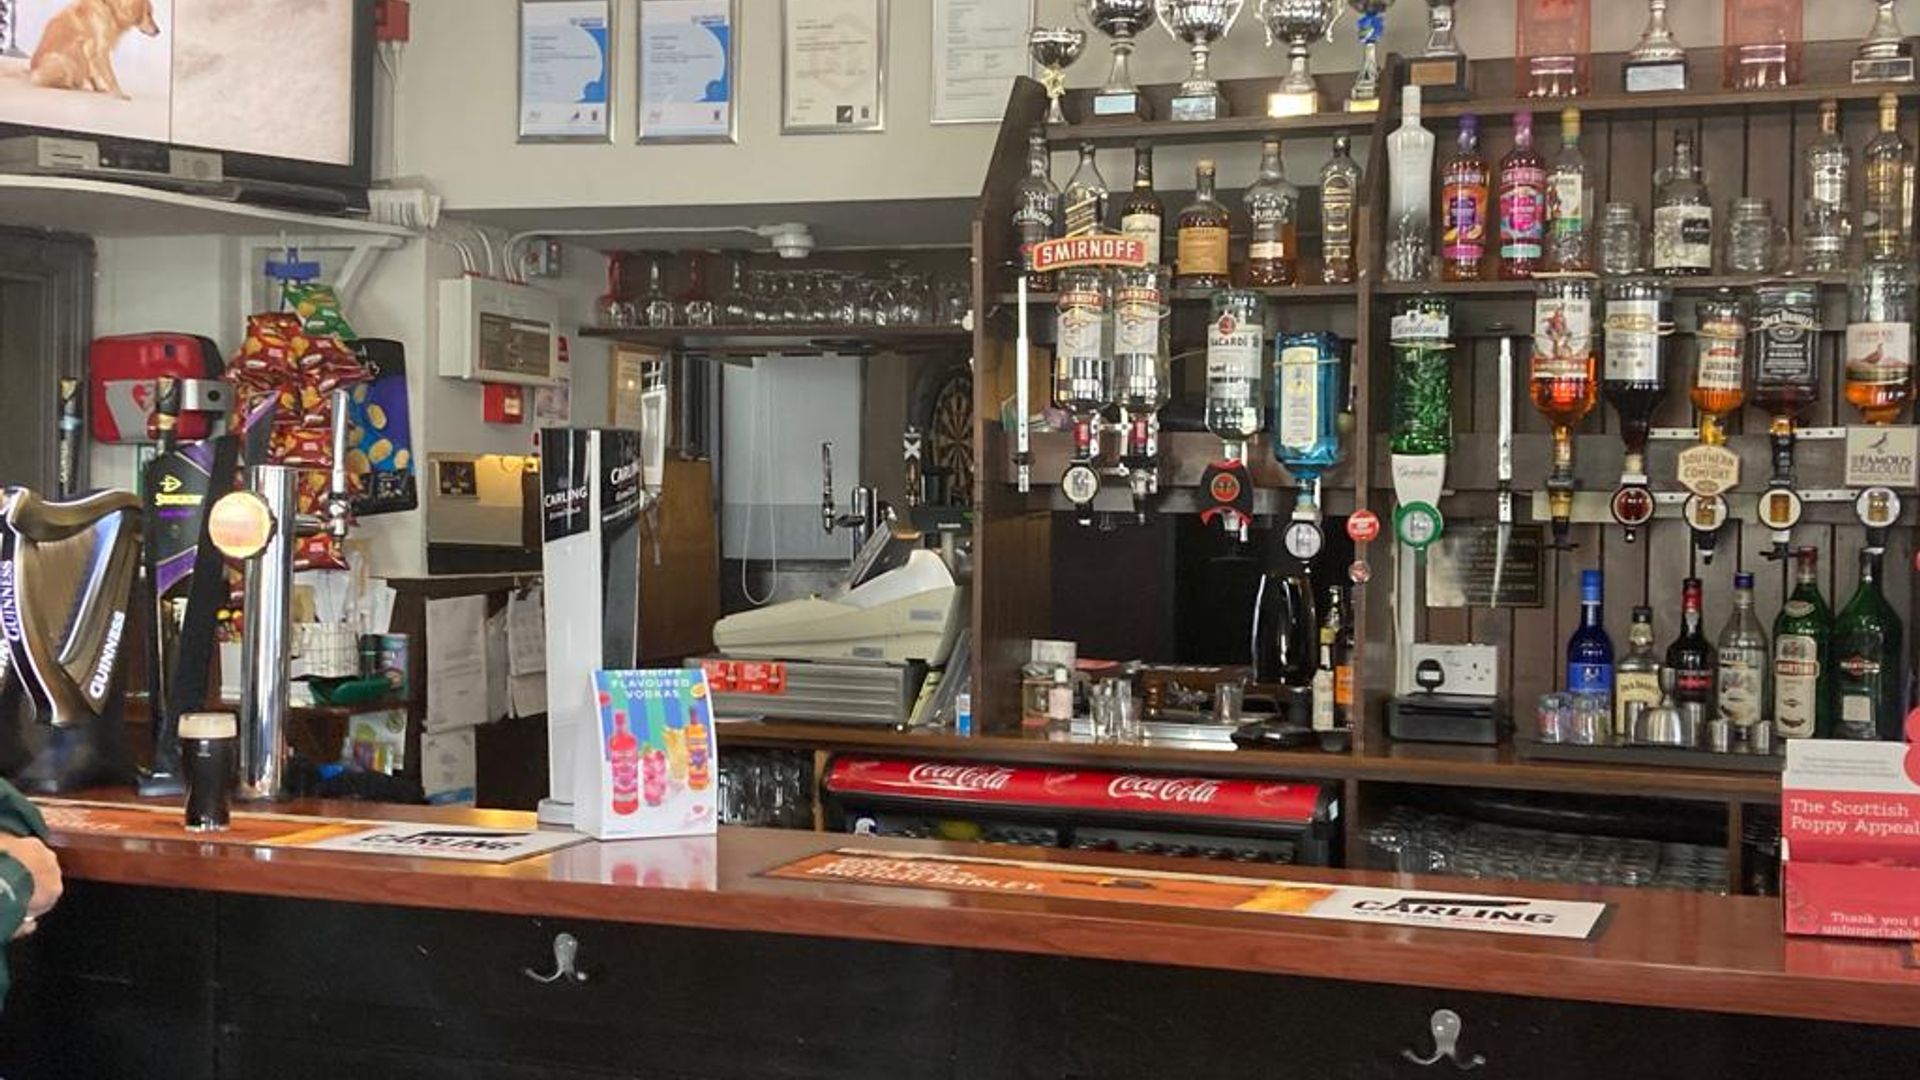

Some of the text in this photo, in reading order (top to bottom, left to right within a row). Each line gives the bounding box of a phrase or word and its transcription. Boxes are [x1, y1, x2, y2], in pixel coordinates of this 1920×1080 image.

[1251, 208, 1283, 221] JURA
[1042, 239, 1137, 264] SMIRNOFF
[1681, 452, 1735, 468] SOUTHERN
[1682, 466, 1731, 480] COMFORT
[544, 485, 588, 507] CARLING
[89, 611, 125, 699] GUINNESS
[610, 678, 691, 690] FLAVOURED
[624, 689, 682, 700] VODKAS
[907, 761, 1015, 791] Coca-Cola
[1107, 775, 1221, 803] Coca-Cola
[1790, 798, 1910, 818] The Scottish
[1790, 815, 1919, 836] Poppy Appeal
[1352, 899, 1557, 924] CARLING
[1830, 912, 1877, 925] Thank
[1880, 916, 1909, 927] you
